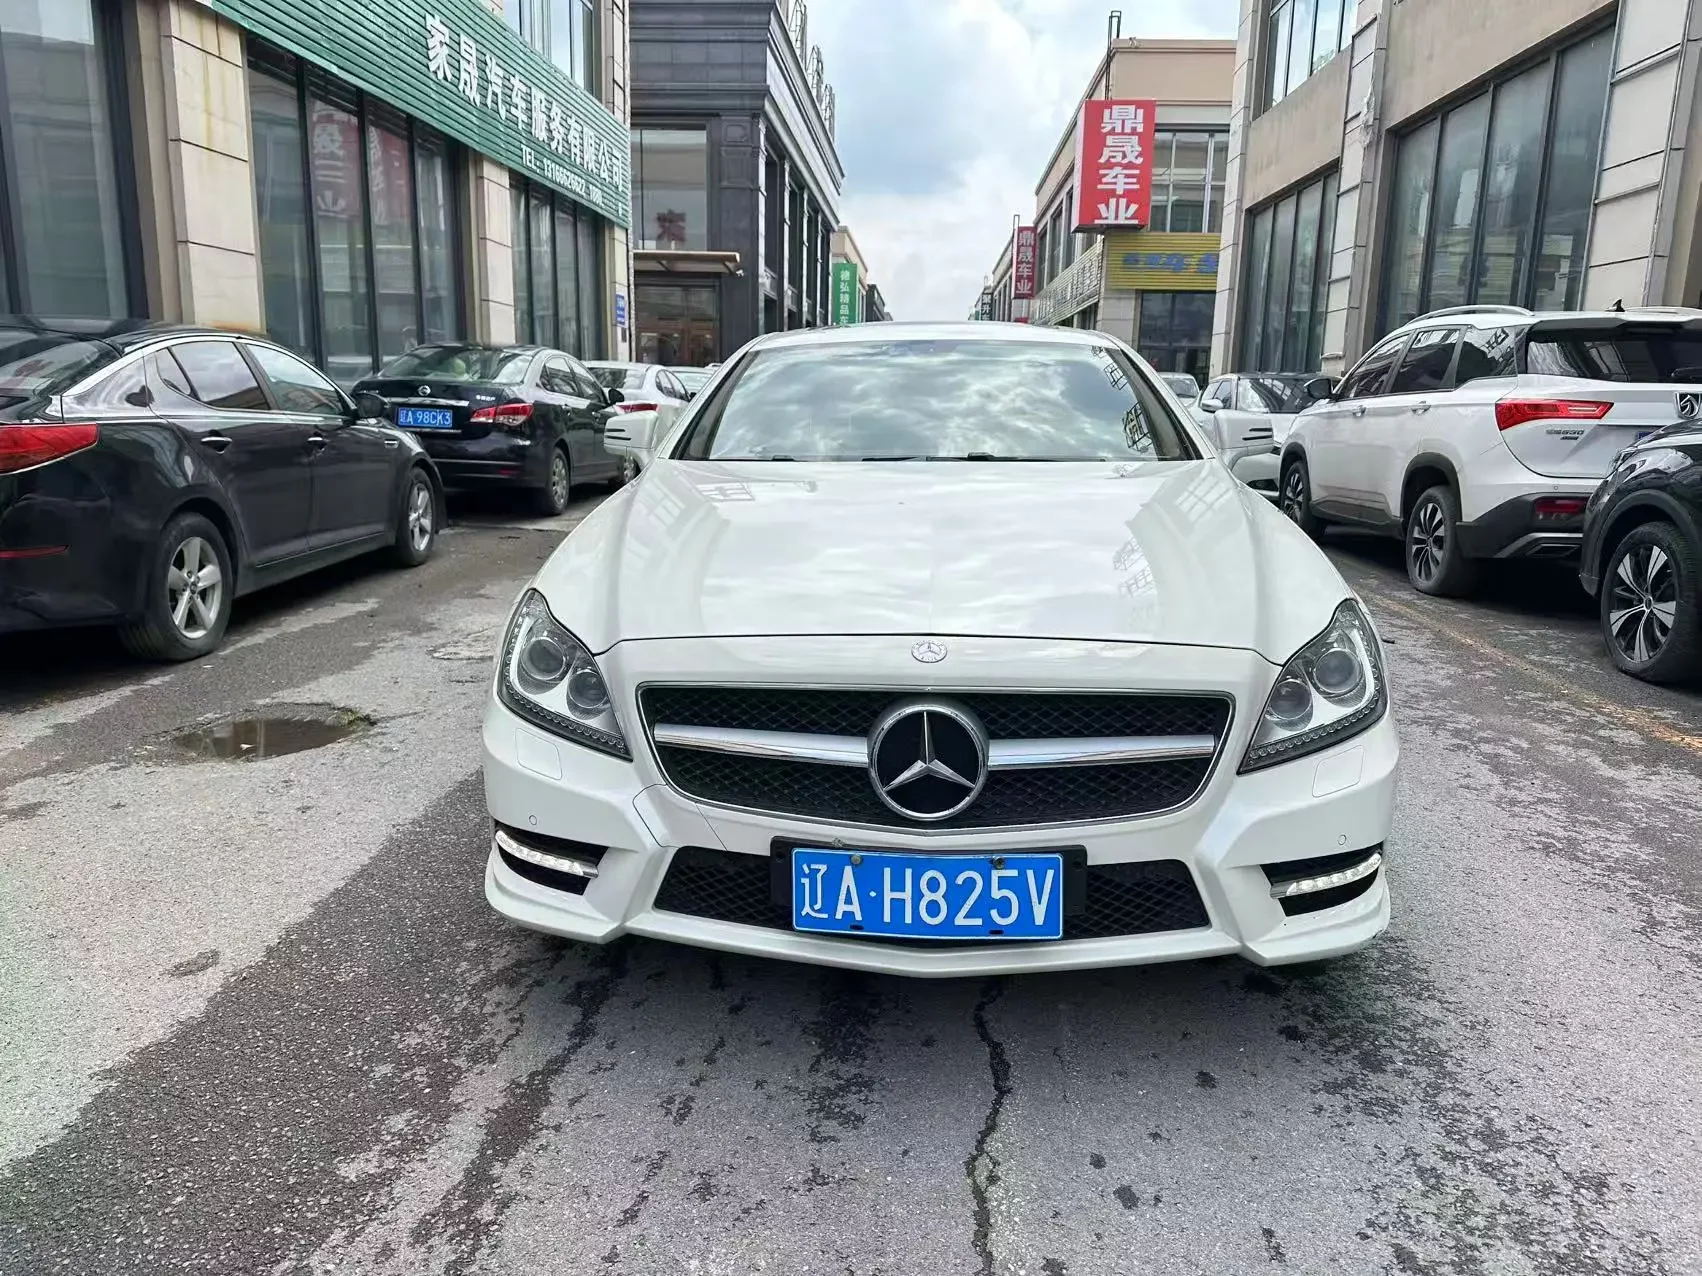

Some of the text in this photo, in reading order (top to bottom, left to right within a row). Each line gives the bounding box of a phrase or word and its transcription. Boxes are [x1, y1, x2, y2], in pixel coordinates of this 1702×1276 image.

[425, 13, 623, 192] 家晟汽车服务有限公司
[1094, 104, 1144, 224] 鼎晟车业
[1016, 230, 1035, 293] 鼎晟车业
[800, 863, 1055, 926] 辽A·H825V
